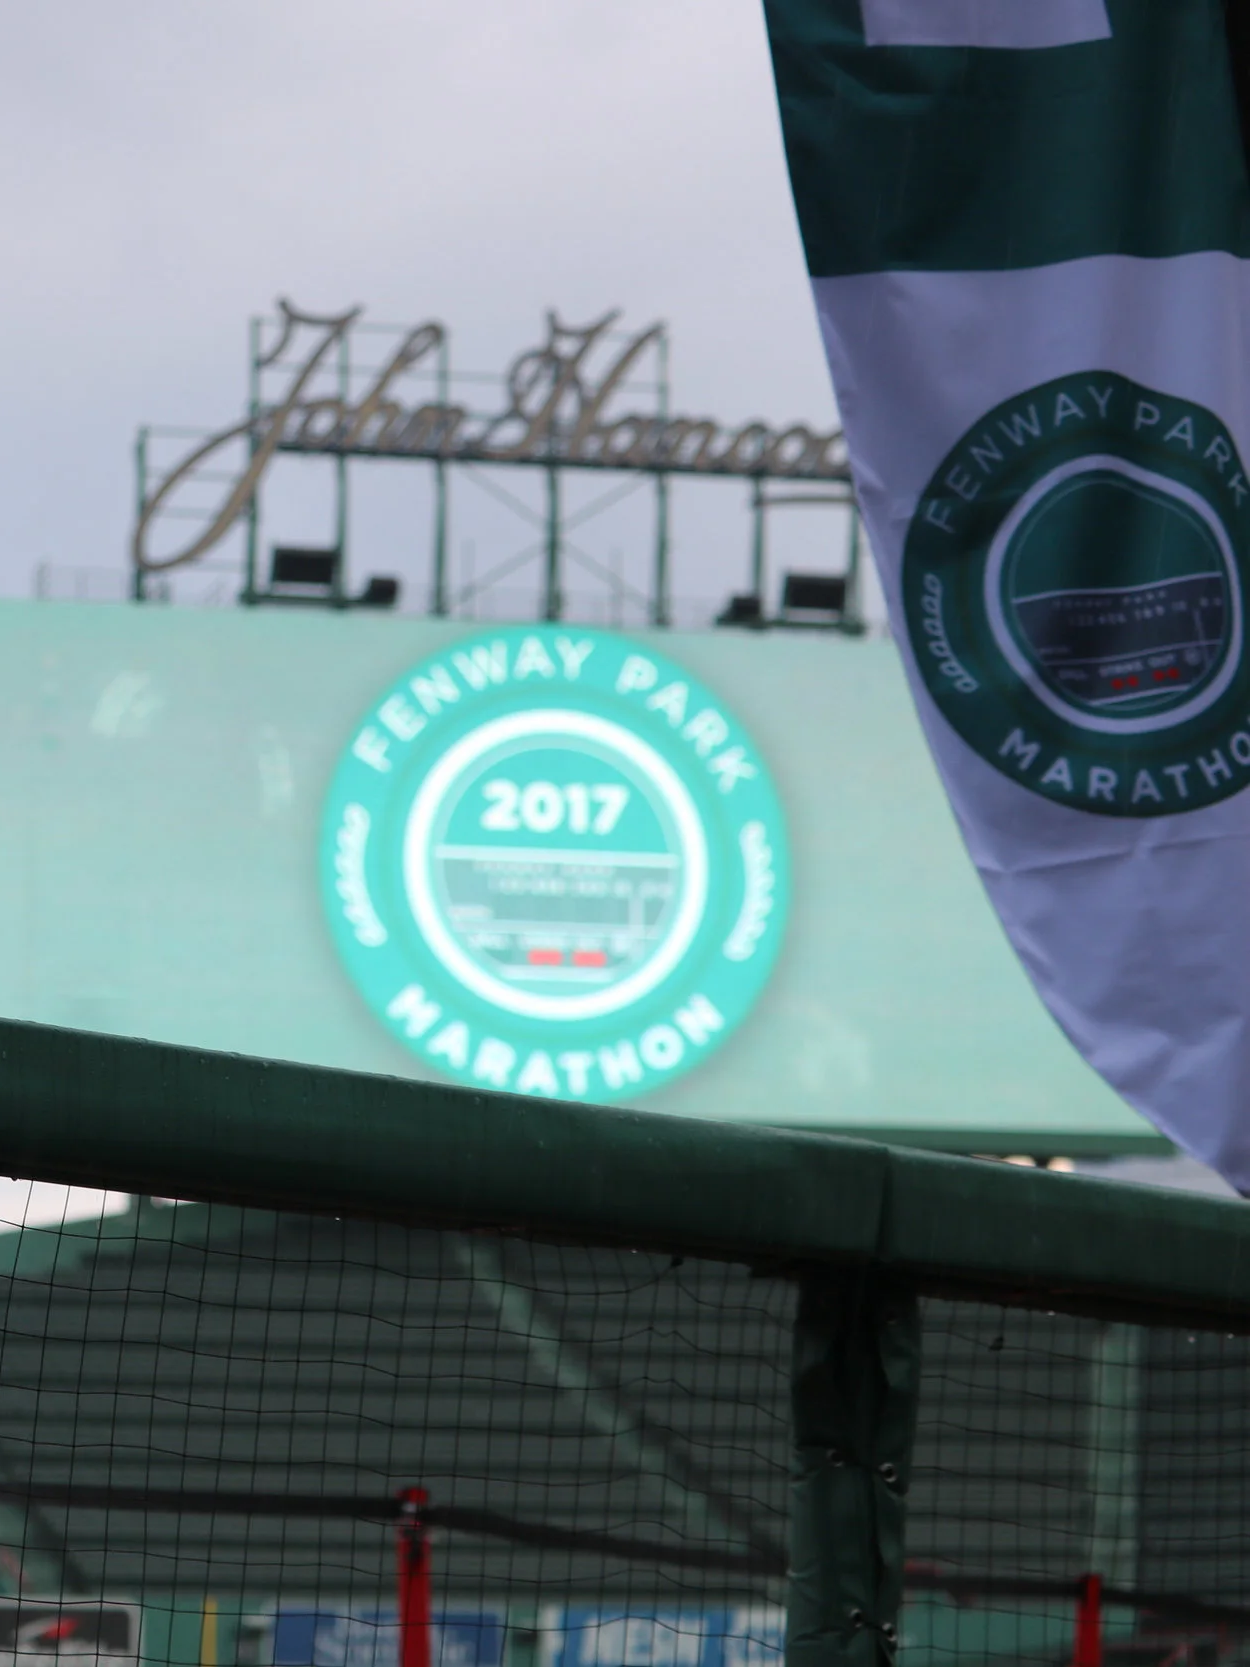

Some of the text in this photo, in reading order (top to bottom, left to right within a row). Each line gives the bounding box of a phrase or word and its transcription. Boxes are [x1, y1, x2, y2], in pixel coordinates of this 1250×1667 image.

[132, 296, 851, 573] John Hancoc
[924, 385, 1249, 534] FENWAY PARK
[350, 635, 759, 794] FENWAY PARK
[998, 714, 1250, 805] MARATHO
[479, 778, 631, 836] 2017
[385, 983, 726, 1097] MARATHON
